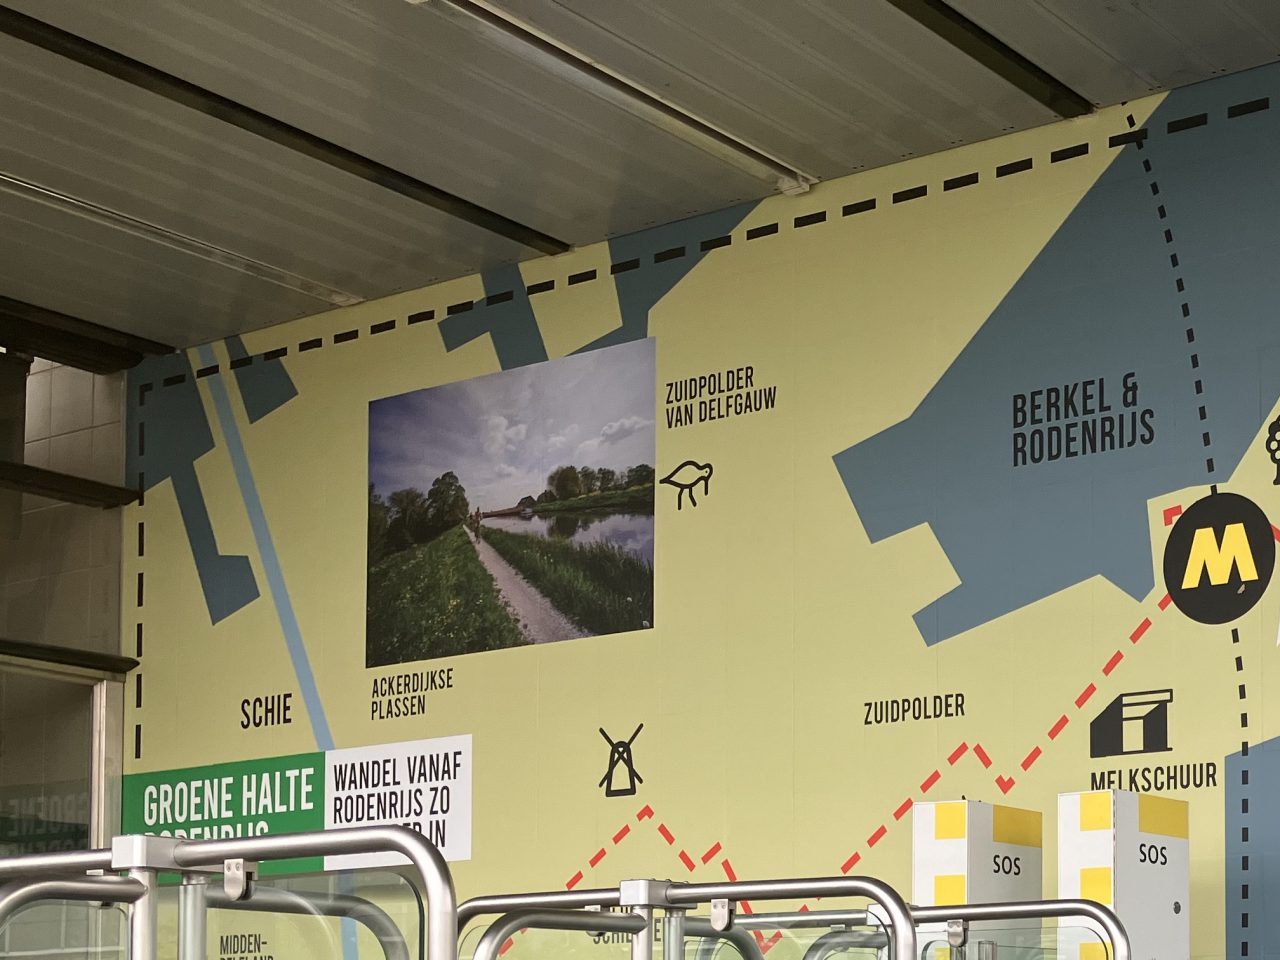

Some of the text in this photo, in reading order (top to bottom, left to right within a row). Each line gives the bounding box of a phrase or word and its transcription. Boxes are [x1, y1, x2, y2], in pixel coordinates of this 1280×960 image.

[666, 366, 754, 404] ZUIDPOLDER
[1013, 372, 1139, 429] BERKEL &
[666, 386, 776, 429] VAN DELFGAUW
[1013, 409, 1155, 467] RODENRIJS
[372, 668, 453, 698] ACKERDIJKSE
[241, 693, 292, 729] SCHIE
[371, 695, 426, 720] PLASSEN
[864, 694, 965, 725] ZUIDPOLDER
[334, 751, 462, 791] WANDEL VANAF
[1091, 762, 1217, 793] MELKSCHUUR
[143, 767, 314, 826] GROENE HALTE
[334, 785, 450, 824] RODENRIJS ZO
[428, 820, 446, 848] IN
[993, 854, 1021, 875] SOS
[1139, 843, 1168, 866] SOS
[220, 934, 267, 955] MIDDEN-
